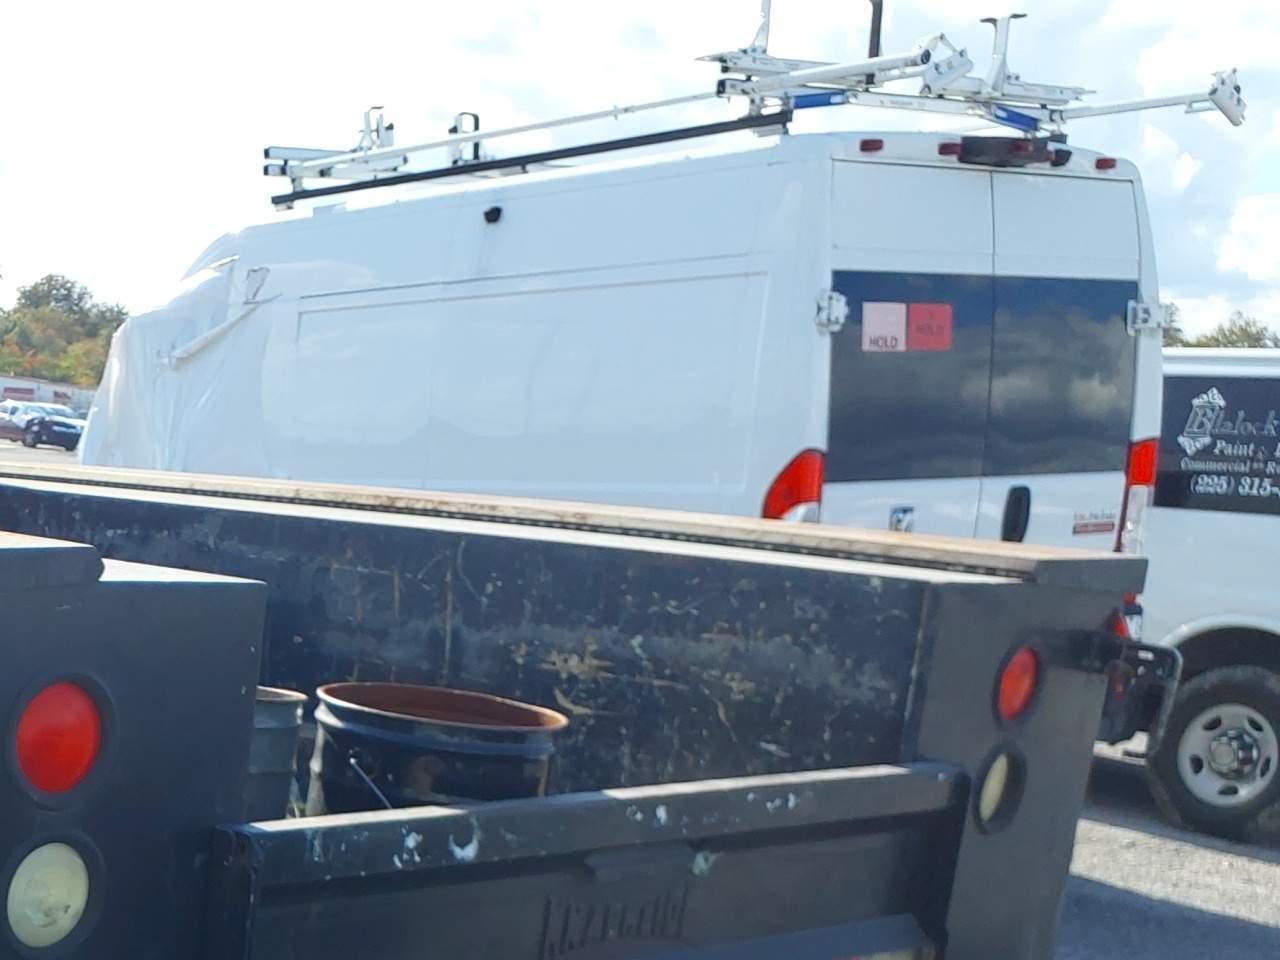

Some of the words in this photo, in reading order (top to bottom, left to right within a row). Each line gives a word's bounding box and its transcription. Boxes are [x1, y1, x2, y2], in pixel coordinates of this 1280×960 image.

[869, 335, 898, 349] HOLD
[1213, 440, 1255, 457] Paint
[1181, 457, 1250, 473] Commercial
[1190, 474, 1235, 496] (225)
